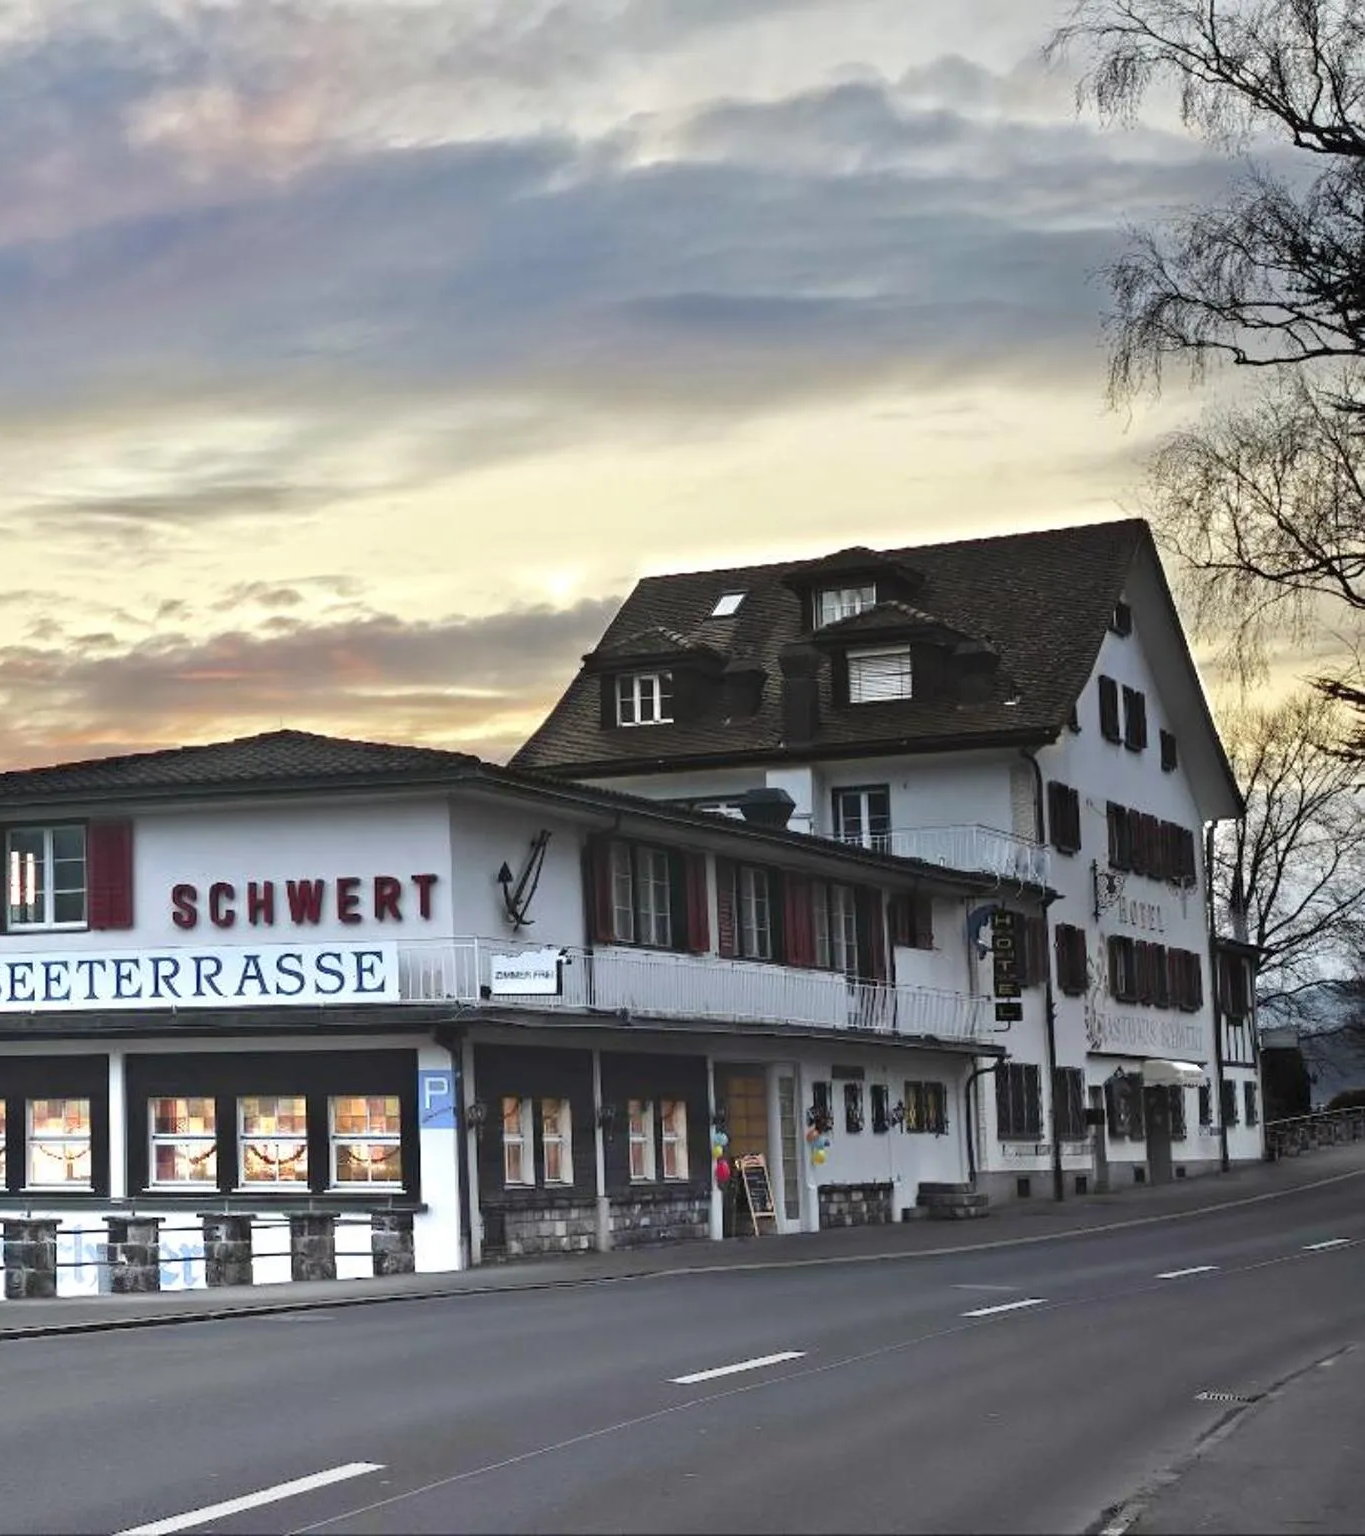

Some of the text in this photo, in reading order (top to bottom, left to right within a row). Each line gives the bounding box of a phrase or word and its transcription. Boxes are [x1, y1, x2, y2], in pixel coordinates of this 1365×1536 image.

[171, 874, 439, 930] SCHWERT
[994, 911, 1017, 1017] HOTEL
[424, 1076, 448, 1109] P
